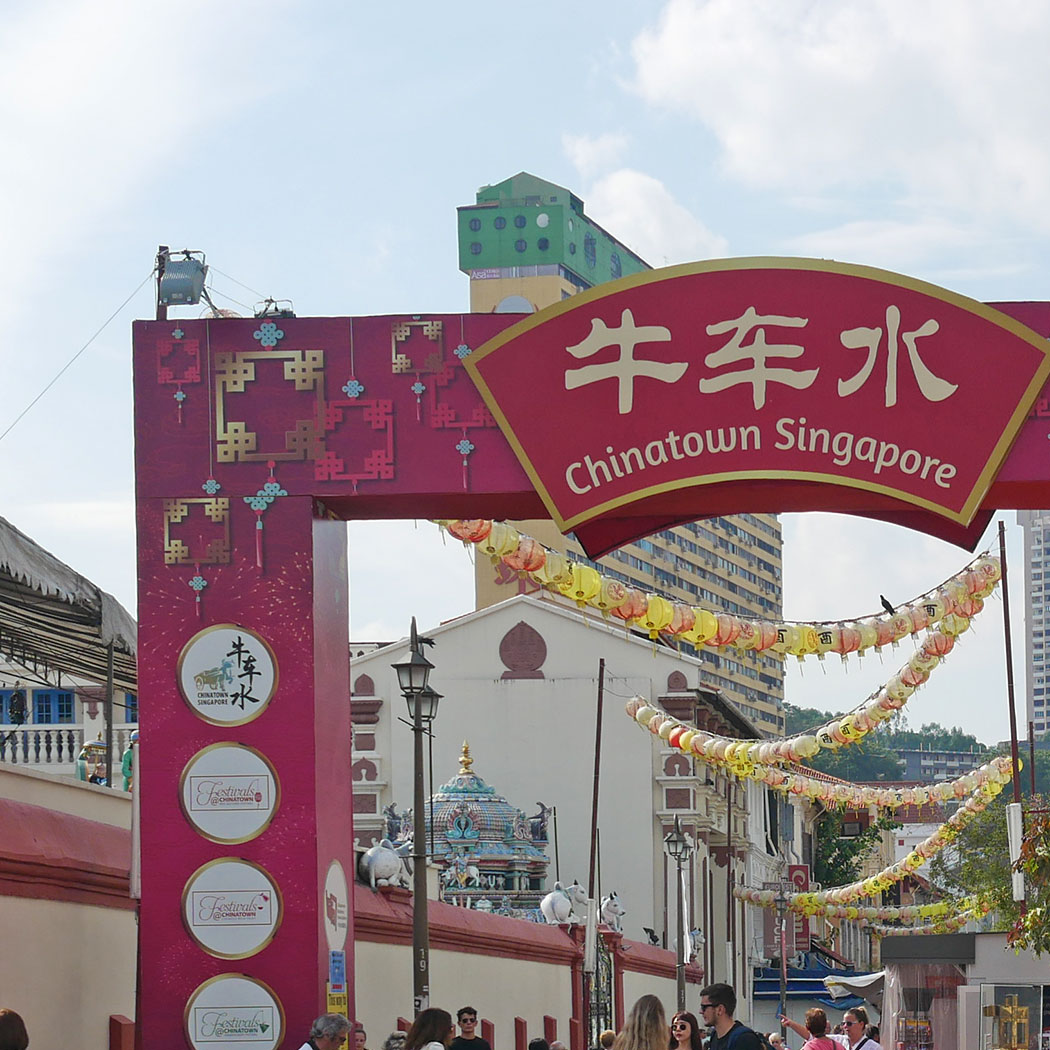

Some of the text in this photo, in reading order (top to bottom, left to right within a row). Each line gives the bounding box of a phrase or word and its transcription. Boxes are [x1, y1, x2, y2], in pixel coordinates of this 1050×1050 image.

[564, 304, 959, 414] 牛车水
[564, 417, 958, 495] Chinatown Singapore
[196, 779, 255, 806] Festivals
[198, 894, 258, 921] Festivals
[200, 1010, 260, 1038] Festivals
